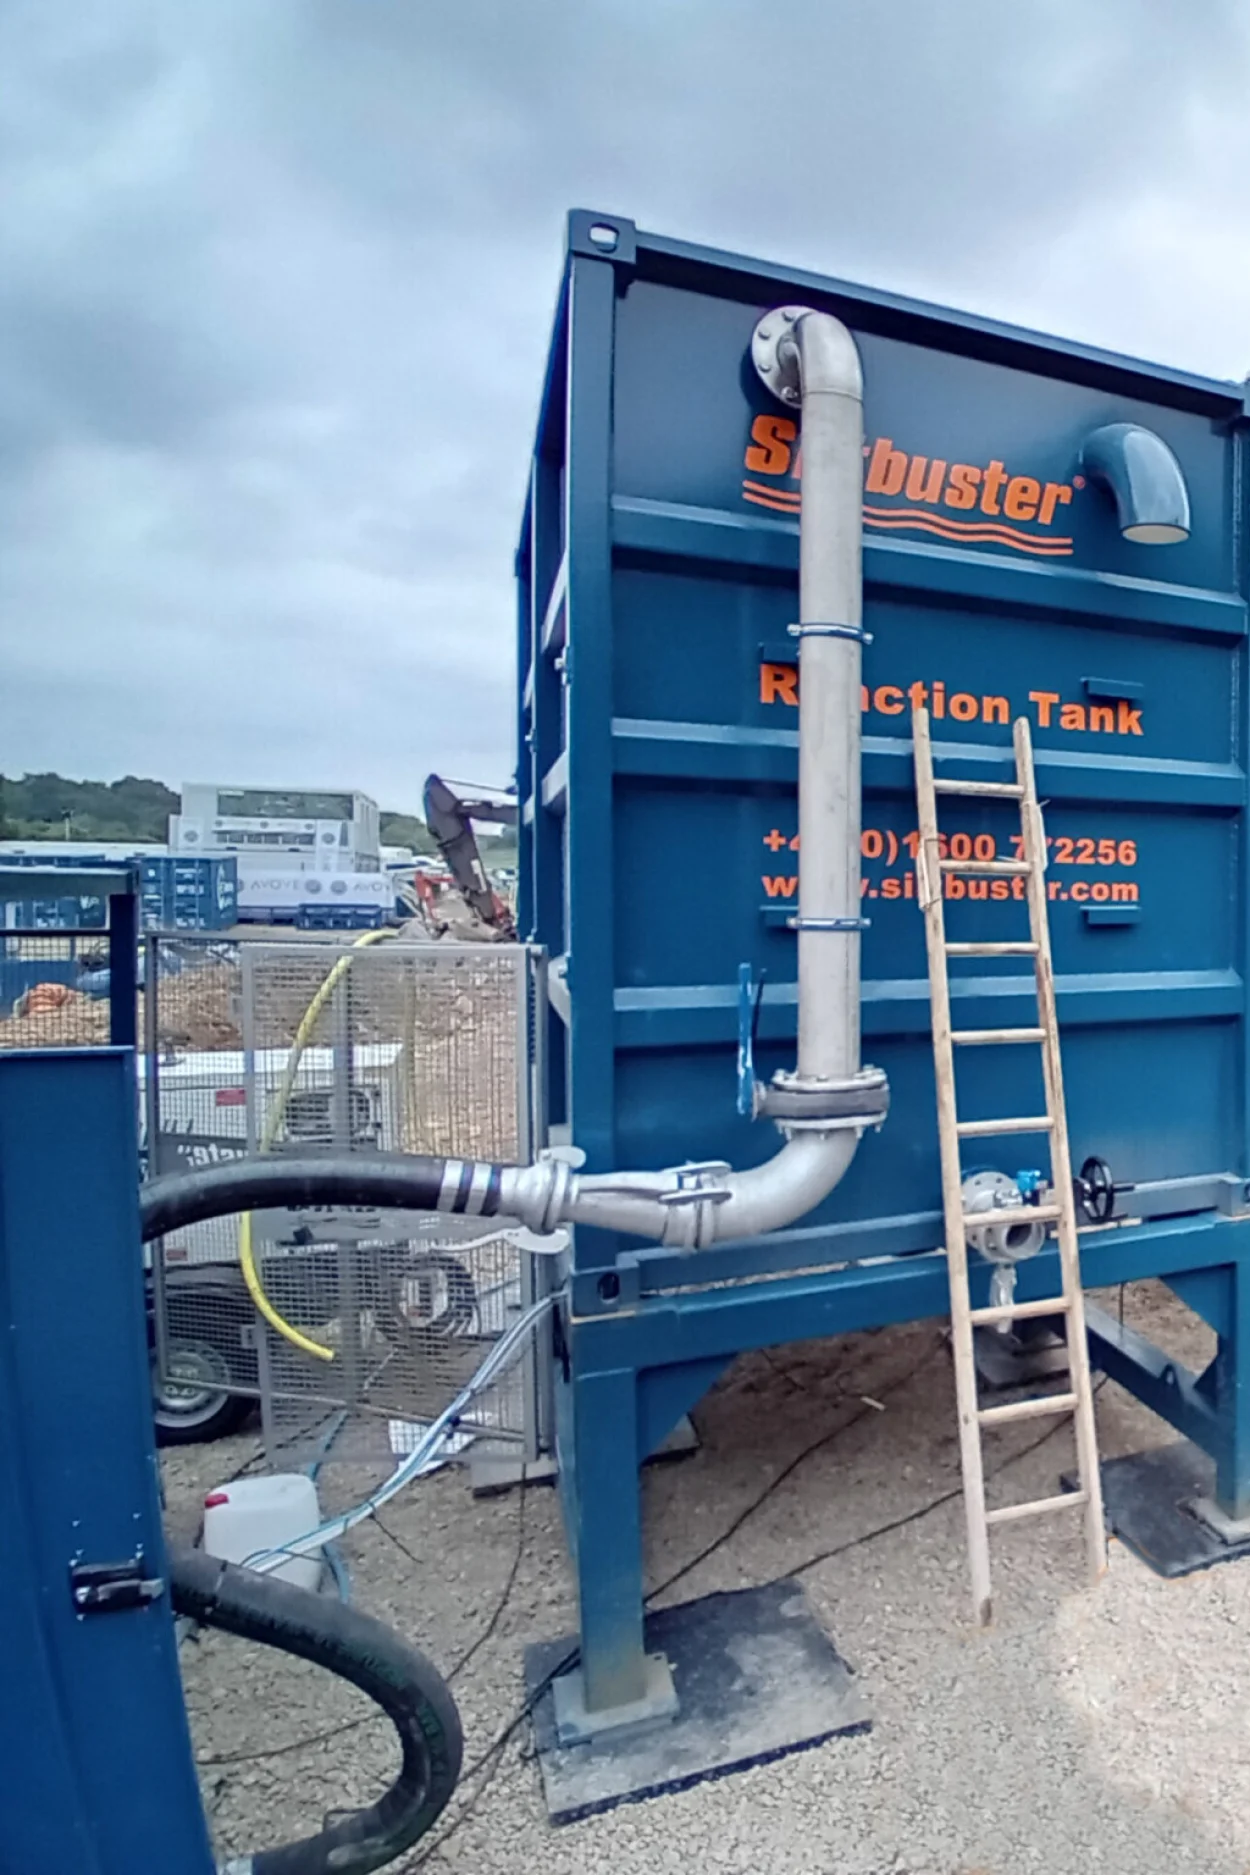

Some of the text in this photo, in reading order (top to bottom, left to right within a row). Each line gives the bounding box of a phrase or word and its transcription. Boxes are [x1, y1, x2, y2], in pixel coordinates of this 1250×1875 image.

[744, 414, 1072, 525] Sbuster
[760, 663, 1145, 736] Rction Tank
[1009, 834, 1138, 867] 72256
[761, 872, 1140, 902] w.sibustr.com
